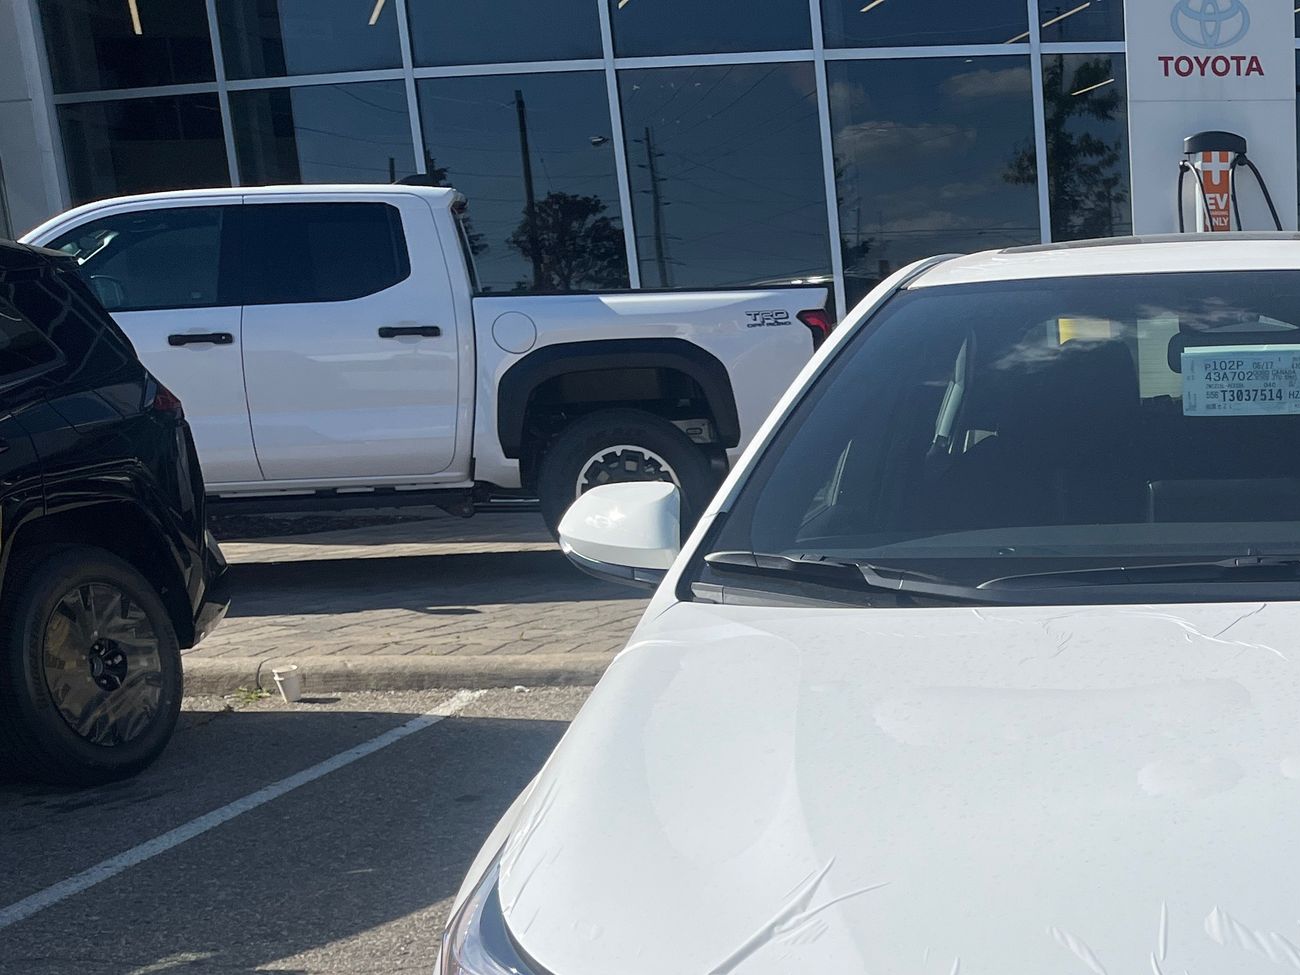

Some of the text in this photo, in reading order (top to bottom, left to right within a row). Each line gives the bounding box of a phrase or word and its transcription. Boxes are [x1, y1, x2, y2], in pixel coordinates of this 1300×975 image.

[1158, 55, 1265, 77] TOYOTA
[1204, 193, 1228, 210] EV
[1211, 216, 1229, 226] NLY
[745, 310, 789, 324] TRD
[1204, 371, 1253, 382] 43A702
[1220, 388, 1283, 402] T3037514
[1288, 390, 1300, 400] HZ
